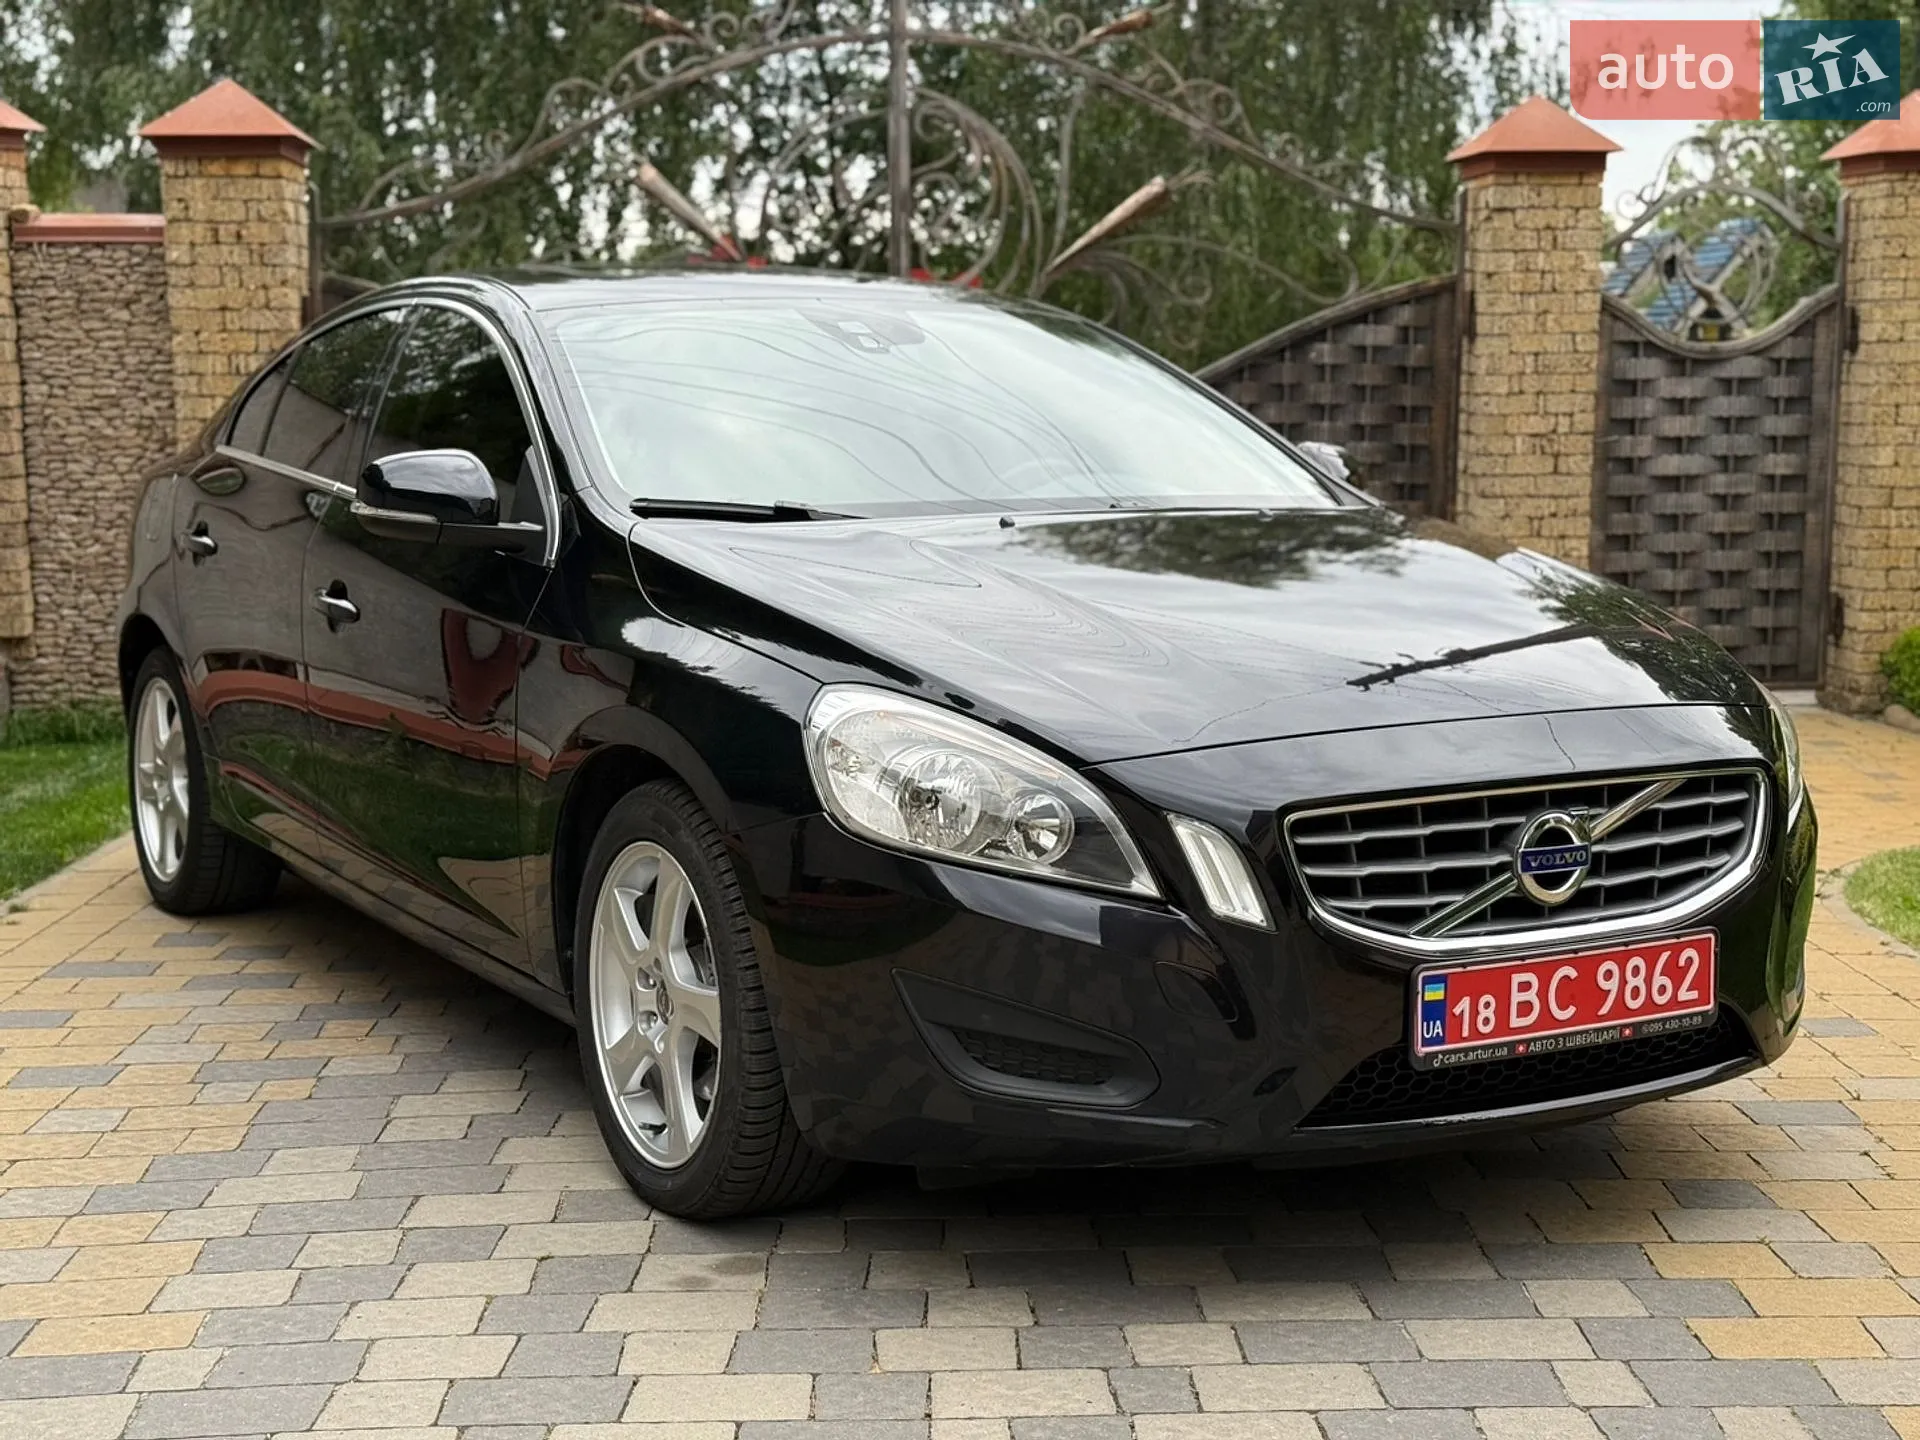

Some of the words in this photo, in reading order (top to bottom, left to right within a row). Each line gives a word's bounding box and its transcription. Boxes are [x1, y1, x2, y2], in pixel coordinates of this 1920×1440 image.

[1526, 850, 1586, 867] VOLVO
[1452, 994, 1496, 1038] 18
[1510, 966, 1577, 1028] BC
[1597, 948, 1700, 1015] 9862
[1423, 1021, 1443, 1038] UA
[1528, 1039, 1555, 1052] АВТО
[1565, 1028, 1620, 1046] ШВЕЙЦАРІЇ
[1443, 1047, 1508, 1063] cars.artur.ua
